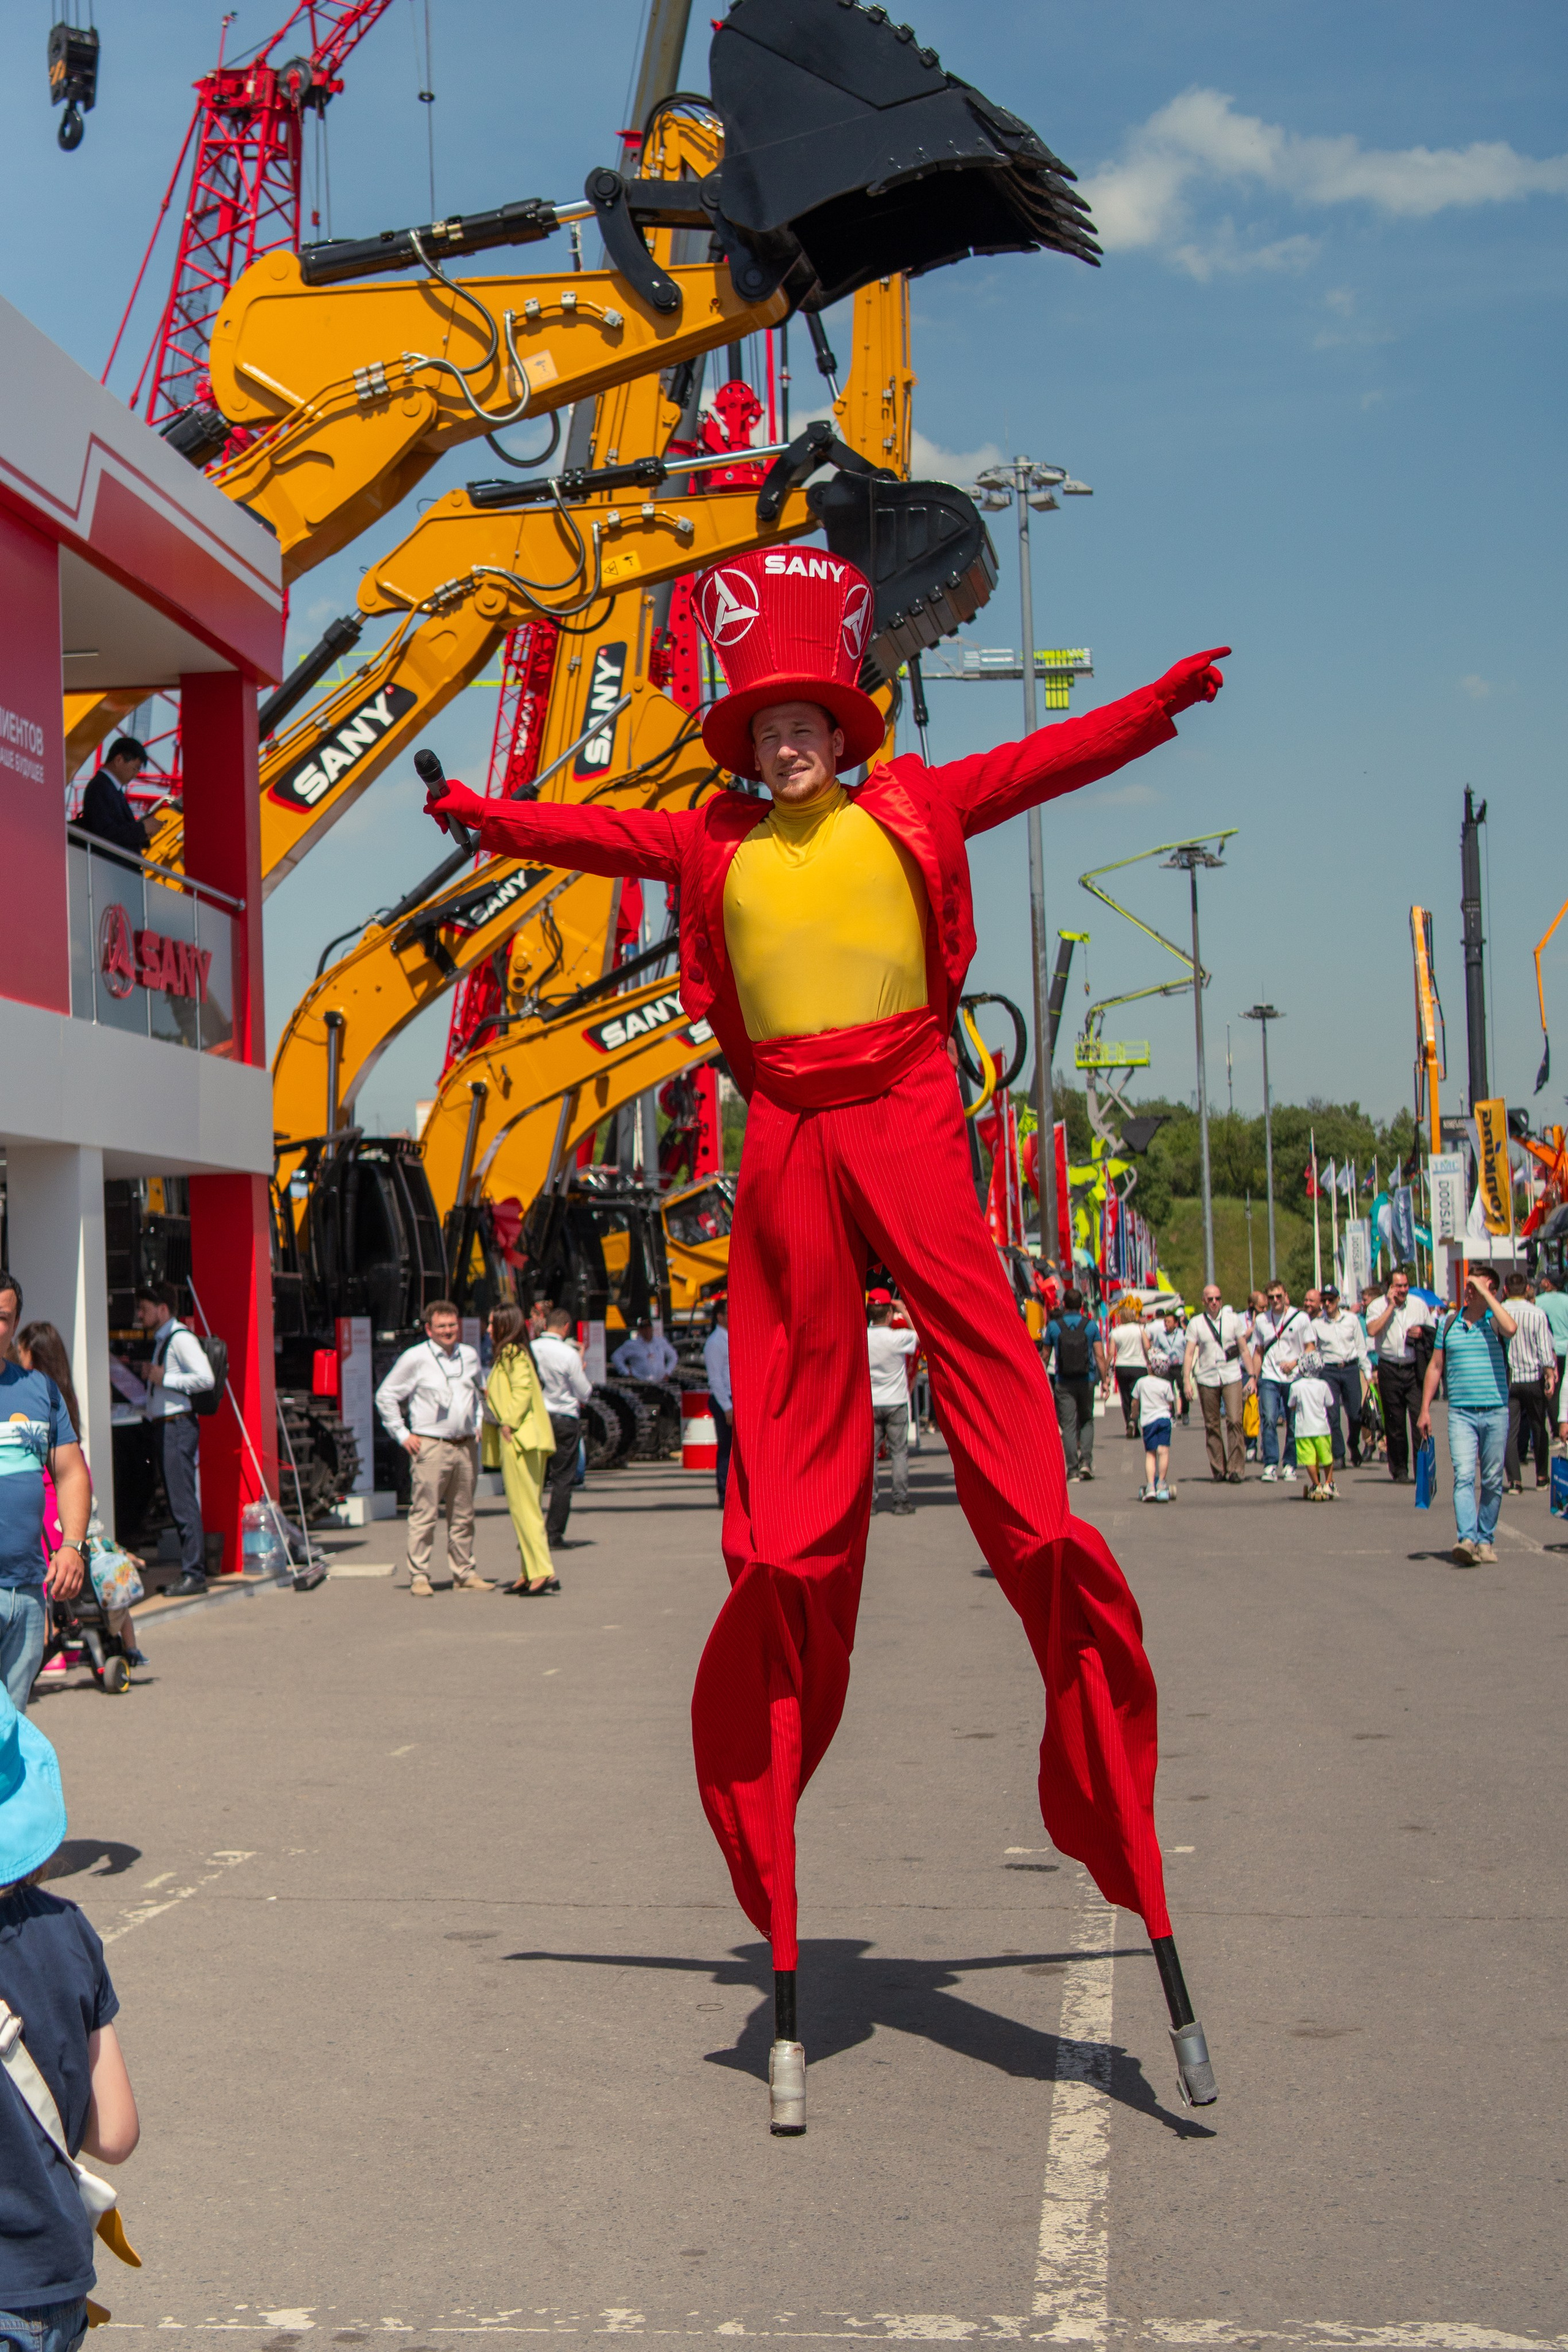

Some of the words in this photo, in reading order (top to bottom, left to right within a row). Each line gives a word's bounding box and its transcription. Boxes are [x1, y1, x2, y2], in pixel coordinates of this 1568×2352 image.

[765, 555, 845, 583] SANY
[584, 655, 621, 764] SANY
[293, 692, 394, 805] SANY
[470, 869, 528, 925] SANY
[140, 929, 213, 1005] SANY
[601, 990, 685, 1050] SANY
[1439, 1180, 1452, 1239] DOOSAN
